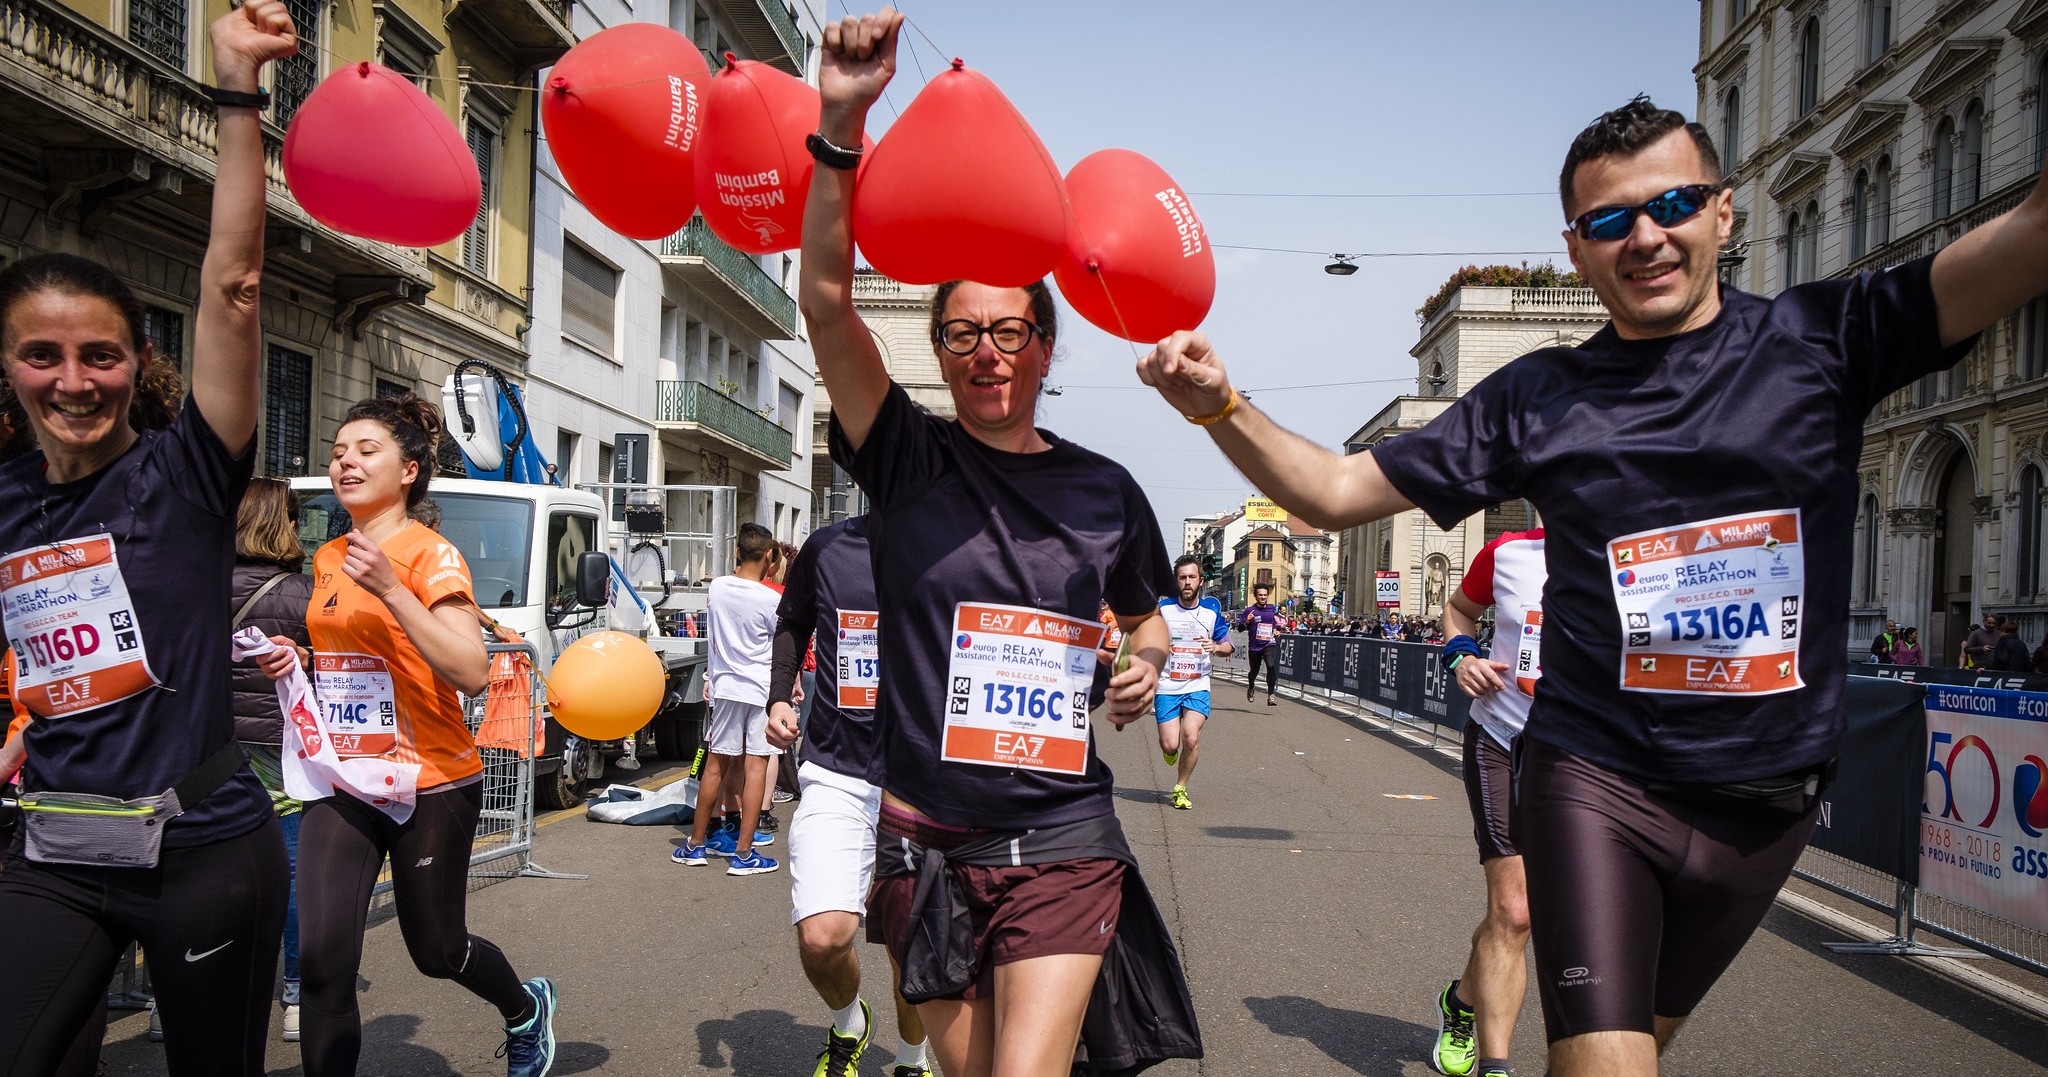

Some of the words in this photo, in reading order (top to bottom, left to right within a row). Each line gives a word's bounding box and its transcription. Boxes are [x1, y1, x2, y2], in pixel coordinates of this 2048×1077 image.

[664, 75, 684, 148] Bambini
[680, 80, 698, 152] Mission
[715, 169, 780, 192] Bambini
[720, 189, 784, 212] Mission
[1155, 191, 1195, 258] Bambini
[1166, 188, 1202, 253] Mission
[1720, 522, 1770, 538] MILANO
[1638, 536, 1678, 557] EA7
[1639, 574, 1668, 584] europ
[1676, 560, 1728, 578] RELAY
[1678, 568, 1756, 588] MARATHON
[16, 587, 49, 605] RELAY
[1378, 582, 1398, 592] 200
[1620, 583, 1670, 596] assistance
[20, 592, 77, 614] MARATHON
[58, 611, 79, 621] TEAM
[848, 616, 866, 625] EA7
[980, 612, 1015, 628] EA7
[1664, 602, 1770, 642] 1316A
[1044, 620, 1082, 635] MILANO
[24, 624, 100, 668] 1316D
[954, 651, 996, 662] assistance
[973, 644, 998, 653] europ
[1003, 644, 1044, 657] RELAY
[320, 659, 336, 667] EA7
[855, 659, 880, 678] 131
[1002, 655, 1062, 670] MARATHON
[1380, 648, 1398, 687] EA7
[1686, 659, 1751, 683] EA7
[996, 670, 1010, 678] PRO
[46, 676, 91, 706] EA7
[984, 682, 1064, 721] 1316C
[1939, 689, 1996, 712] #corricon
[329, 703, 368, 724] 714C
[334, 735, 361, 749] EA7
[994, 732, 1046, 758] EA7
[690, 748, 705, 775] arena
[1922, 731, 2000, 828] 50
[1920, 823, 1951, 848] 1968
[1967, 836, 2000, 862] 2018
[1929, 847, 1956, 866] PROVA
[1960, 856, 1967, 869] DI
[1971, 860, 2001, 879] FUTURO
